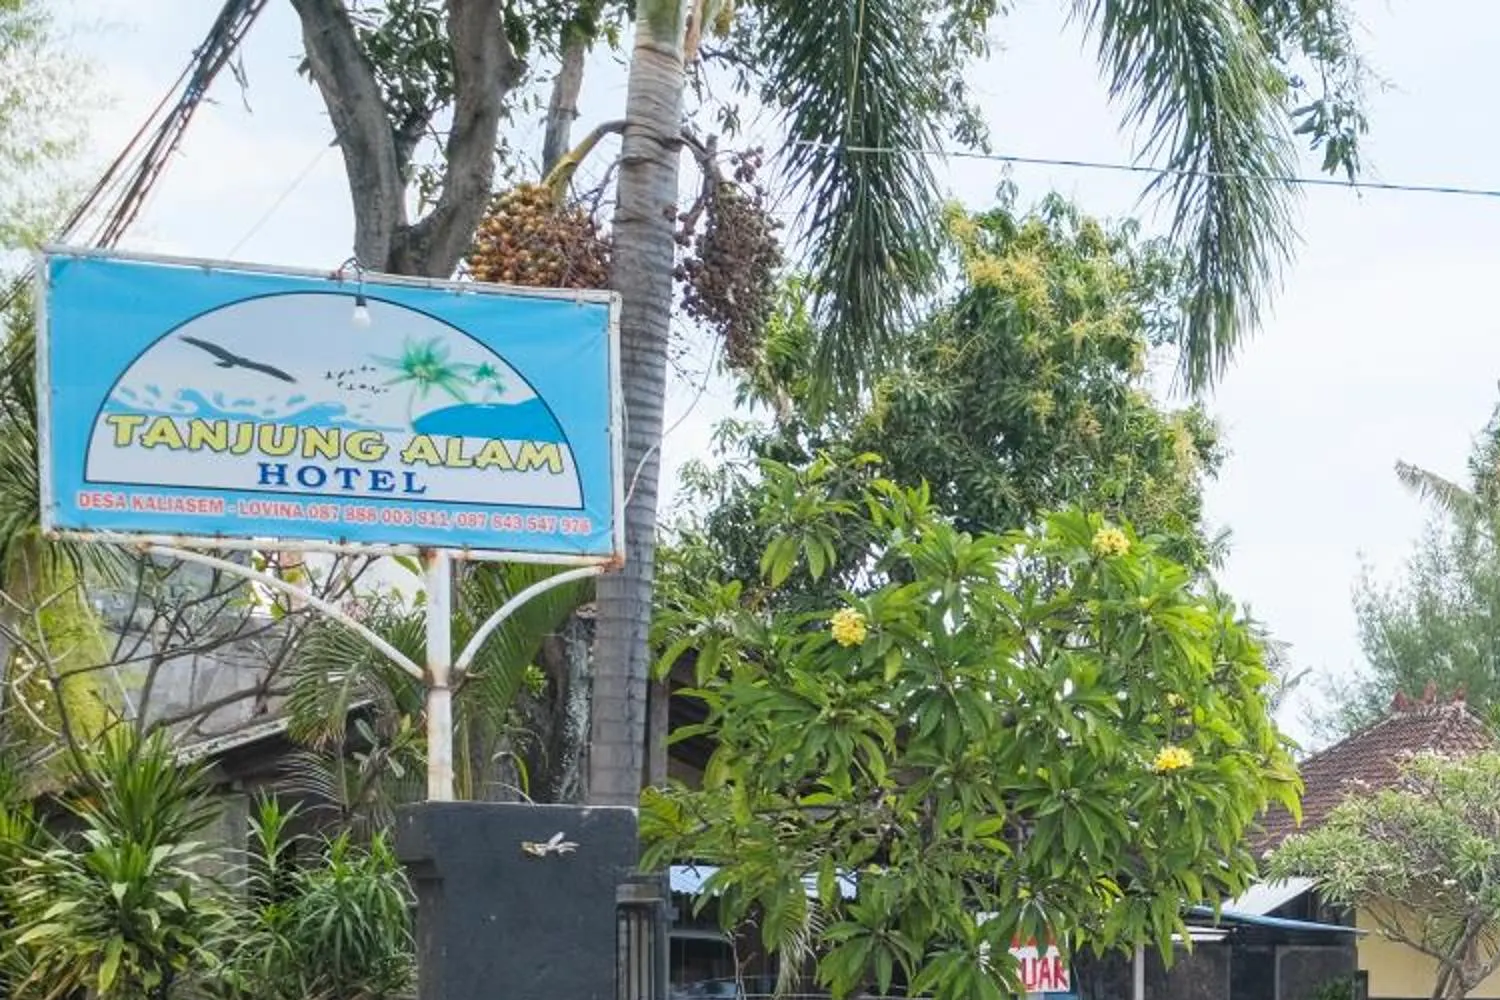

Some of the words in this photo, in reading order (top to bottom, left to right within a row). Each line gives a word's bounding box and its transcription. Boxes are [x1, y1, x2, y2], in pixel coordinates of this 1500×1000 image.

[106, 413, 389, 462] TANJUNG
[400, 433, 564, 474] ALAM
[256, 461, 427, 494] HOTEL
[79, 491, 126, 510] DESA
[132, 494, 224, 514] KALIASEM
[239, 498, 304, 519] LOVINA
